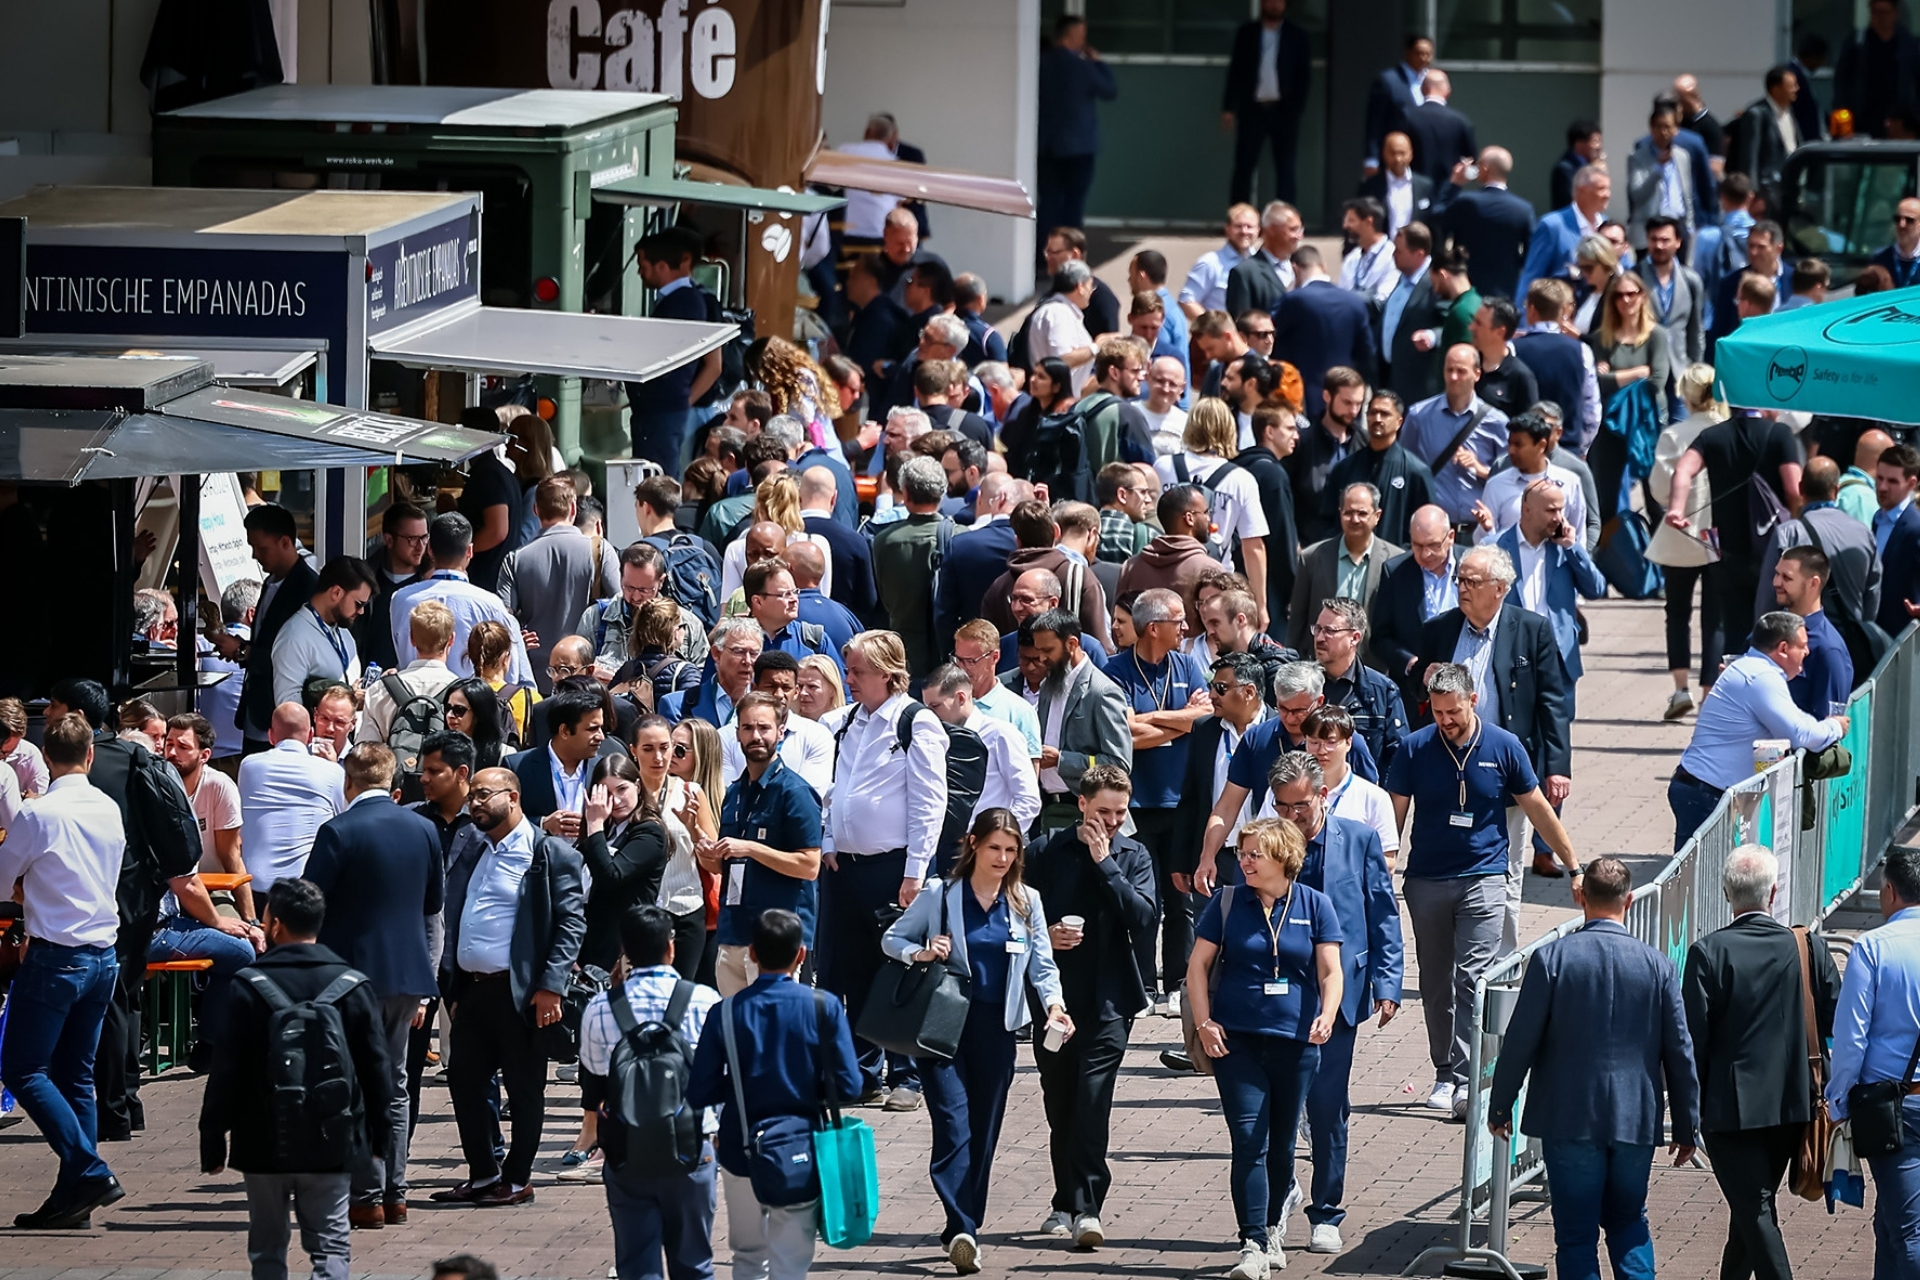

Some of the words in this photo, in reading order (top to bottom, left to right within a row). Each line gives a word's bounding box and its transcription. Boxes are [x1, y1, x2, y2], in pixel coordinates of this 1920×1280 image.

[547, 0, 736, 101] Café
[163, 278, 306, 317] EMPANADAS
[1812, 368, 1840, 385] Safety
